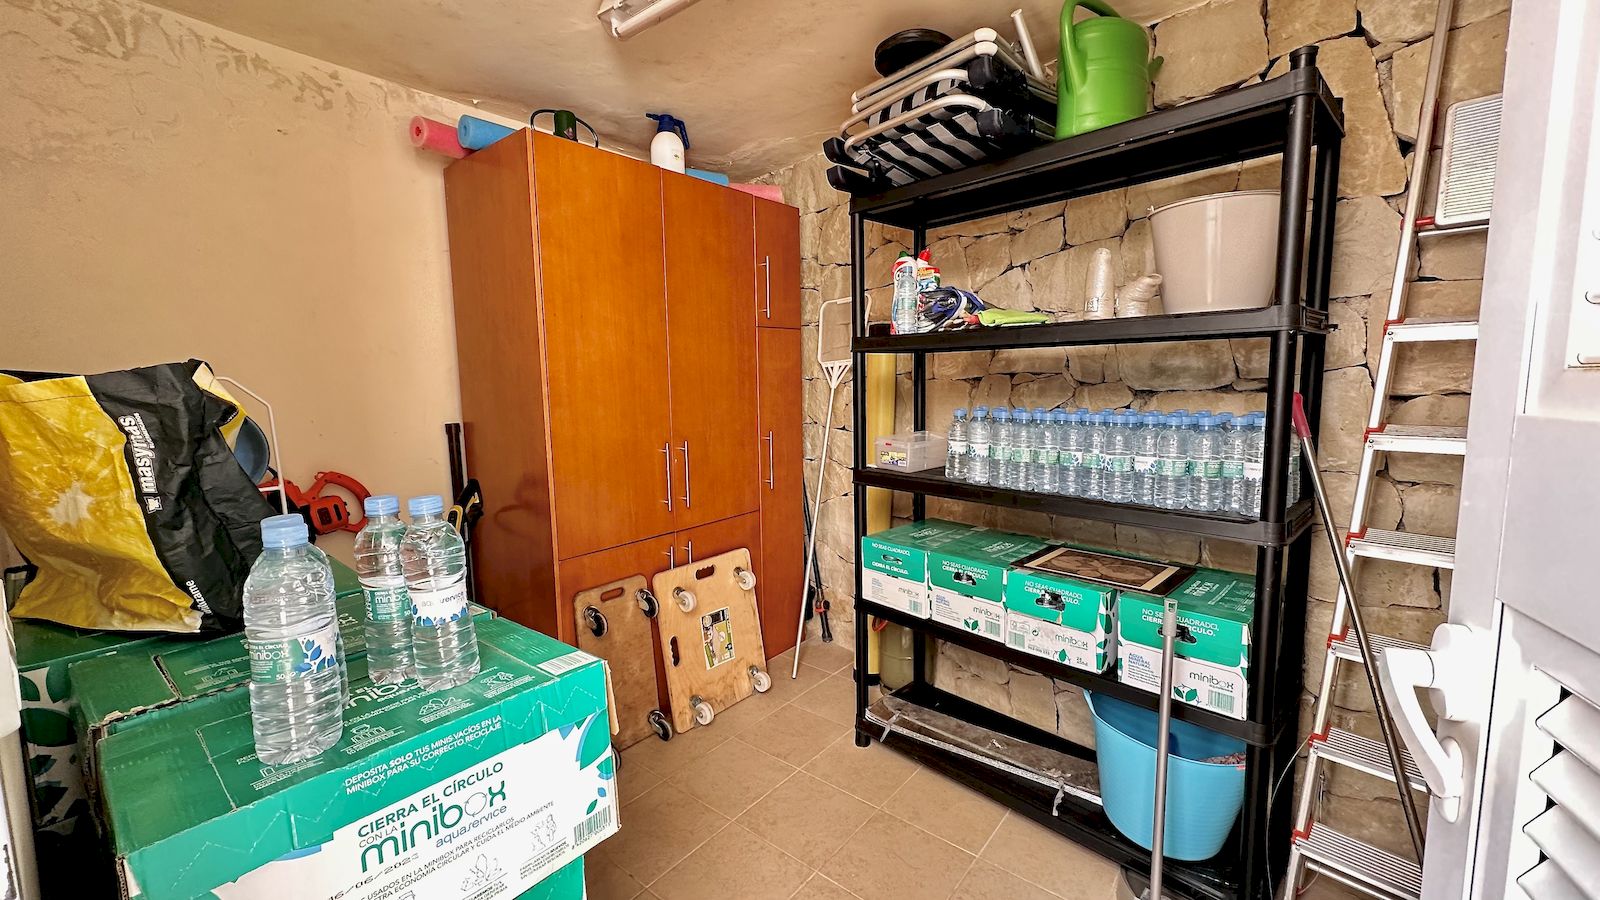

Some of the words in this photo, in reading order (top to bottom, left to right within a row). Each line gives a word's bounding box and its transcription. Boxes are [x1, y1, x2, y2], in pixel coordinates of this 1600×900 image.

[118, 415, 158, 494] masymas
[1142, 615, 1163, 624] CIERR
[1189, 672, 1234, 689] minibox
[345, 763, 388, 787] DEPOSITA
[389, 753, 413, 768] SOLO
[414, 745, 430, 756] TUS
[430, 736, 452, 752] MINIS
[452, 724, 480, 740] VACÍOS
[481, 719, 492, 729] EN
[492, 715, 502, 724] LA
[346, 773, 386, 795] MINIBOX
[387, 764, 409, 778] PARA
[410, 758, 421, 768] SU
[422, 738, 464, 762] CORRECTO
[465, 723, 502, 743] RECICLAJE
[358, 803, 419, 838] CIERRA
[422, 793, 440, 808] EL
[443, 762, 504, 797] CÍRCULO
[361, 780, 506, 873] minibox
[436, 805, 507, 848] aquaservice
[358, 833, 382, 848] CON
[385, 826, 398, 836] LA
[367, 879, 400, 900] USADOS
[401, 872, 412, 882] EN
[414, 867, 422, 876] LA
[424, 850, 454, 869] MINIBOX
[455, 840, 474, 852] PARA
[395, 865, 436, 894] ECONOMÍA
[436, 845, 471, 869] CIRCULAR
[476, 834, 497, 847] CUIDA
[505, 816, 526, 831] MEDIO
